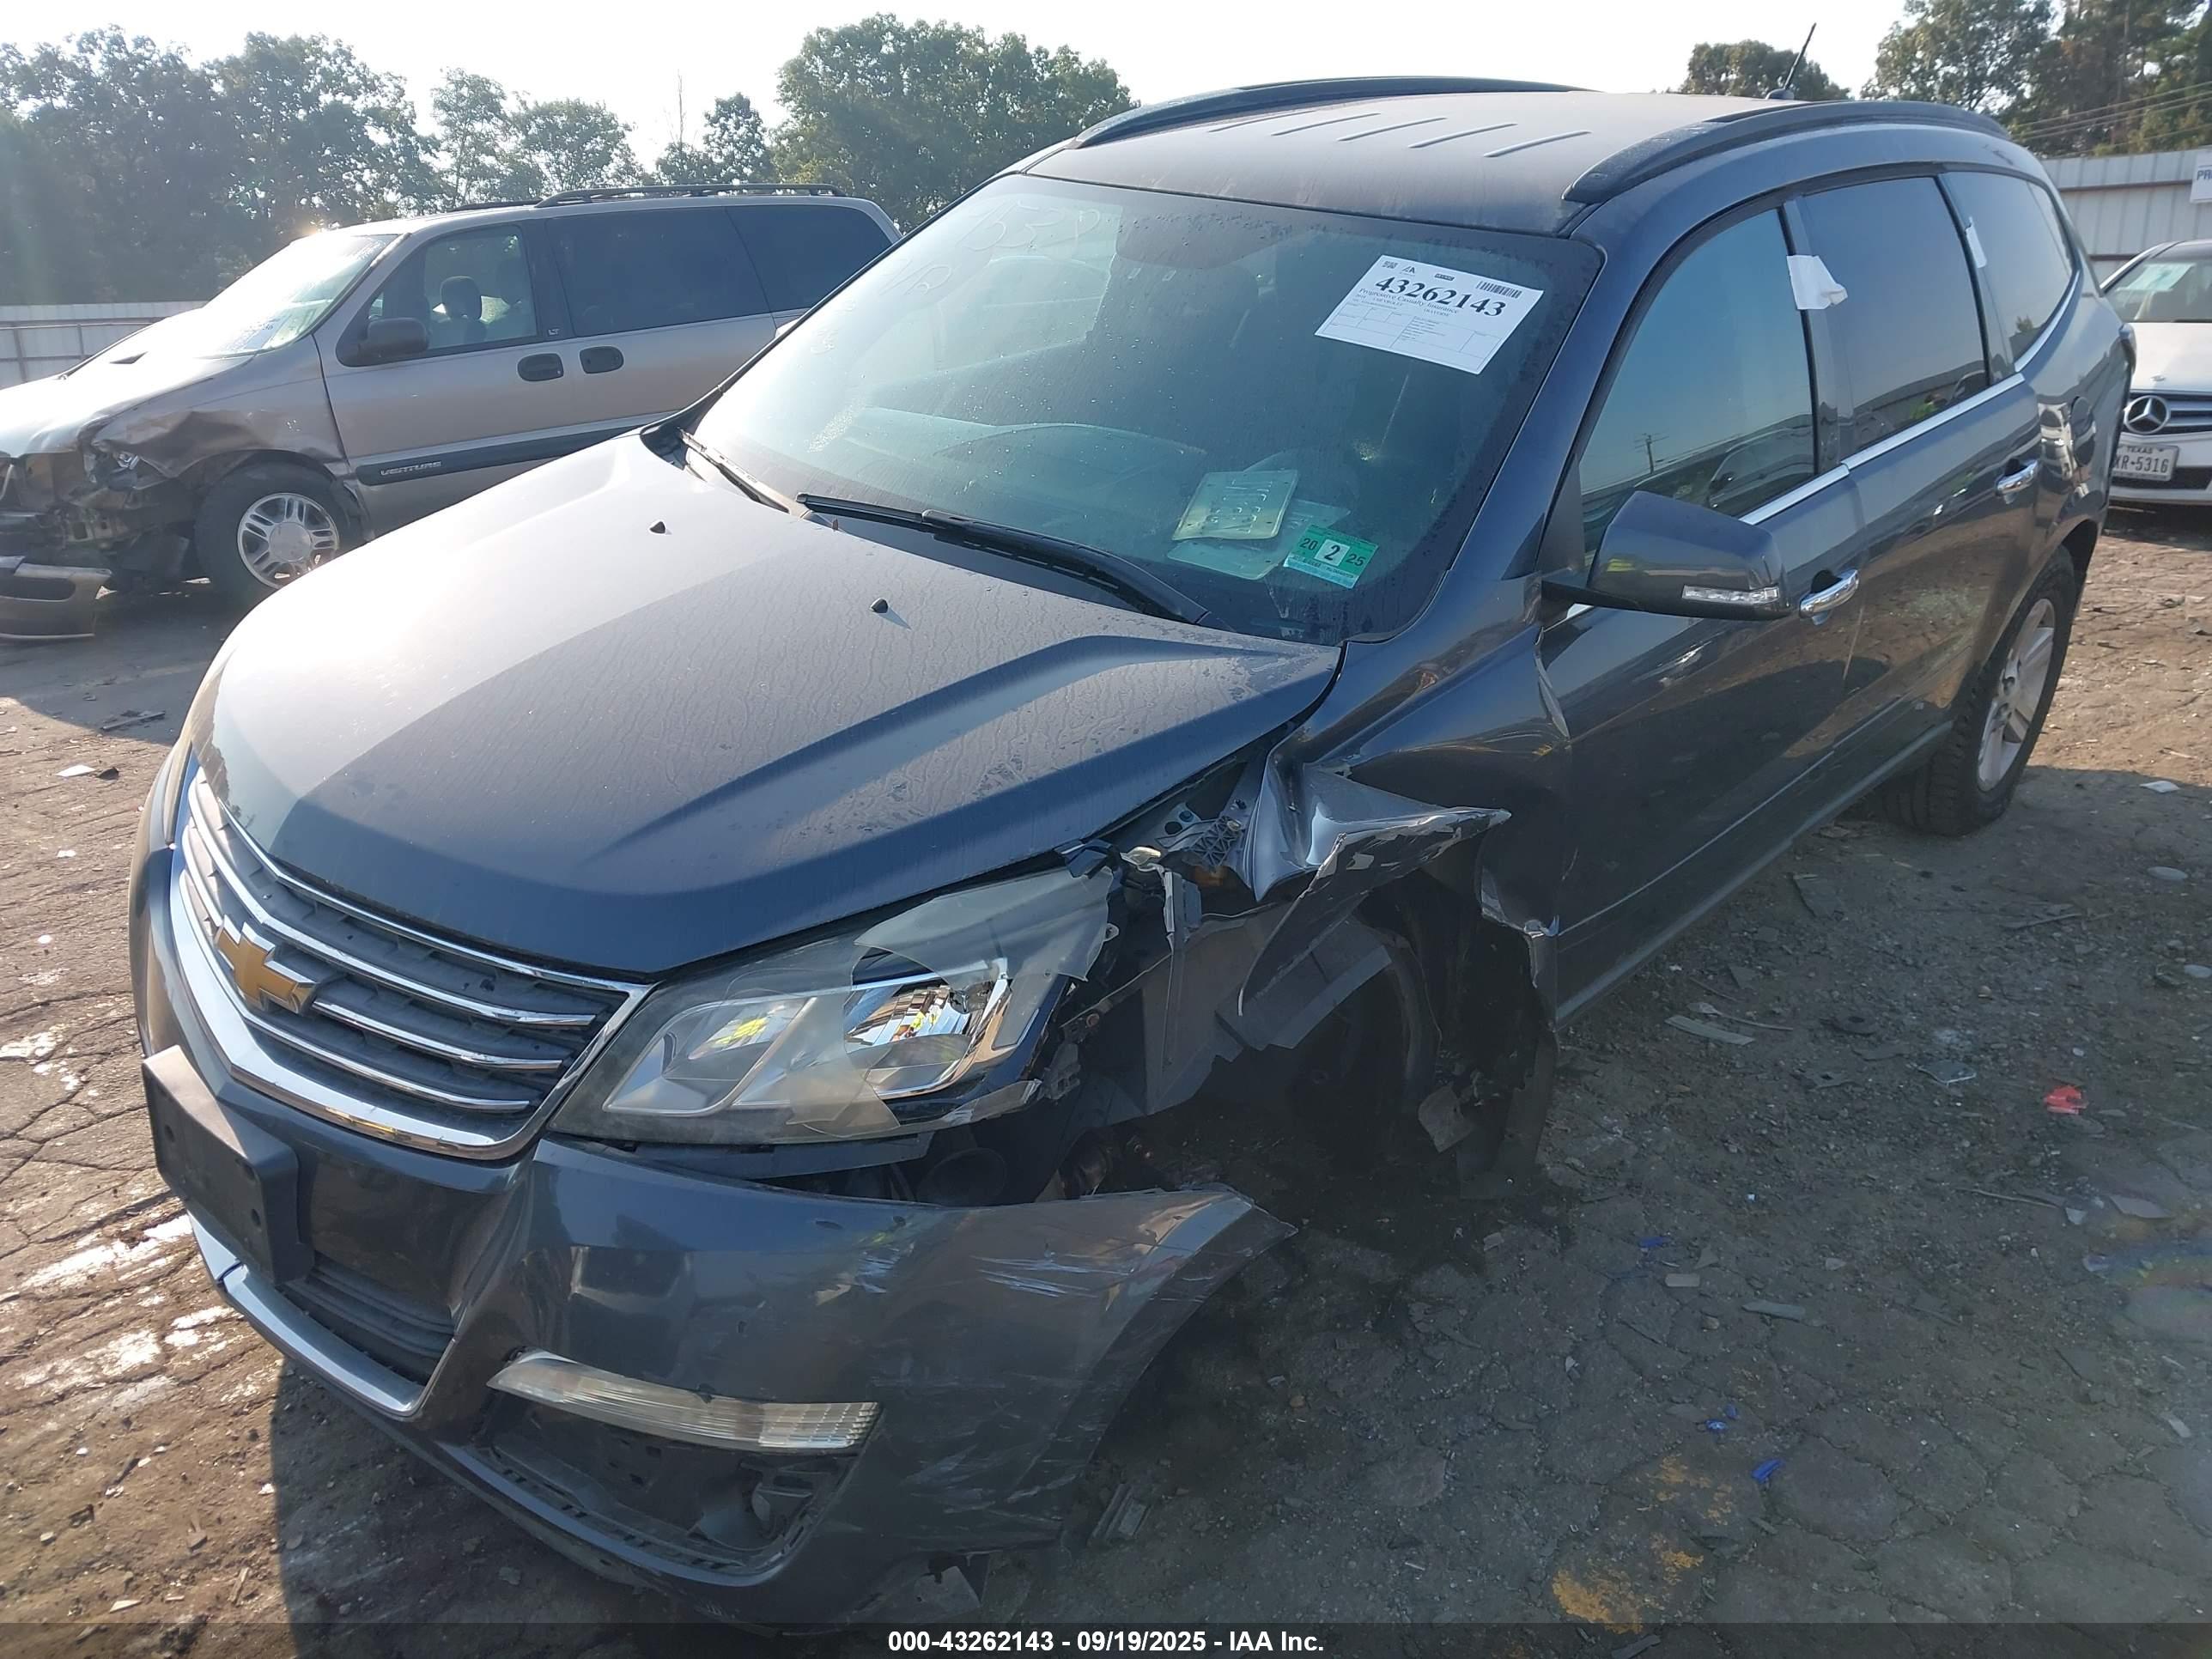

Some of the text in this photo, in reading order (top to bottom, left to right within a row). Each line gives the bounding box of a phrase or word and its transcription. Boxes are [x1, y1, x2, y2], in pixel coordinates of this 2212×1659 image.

[1375, 276, 1506, 317] 43262143
[380, 461, 441, 476] VENTURE
[1299, 538, 1319, 551] 20
[1323, 544, 1341, 562] 2
[1346, 553, 1364, 567] 25
